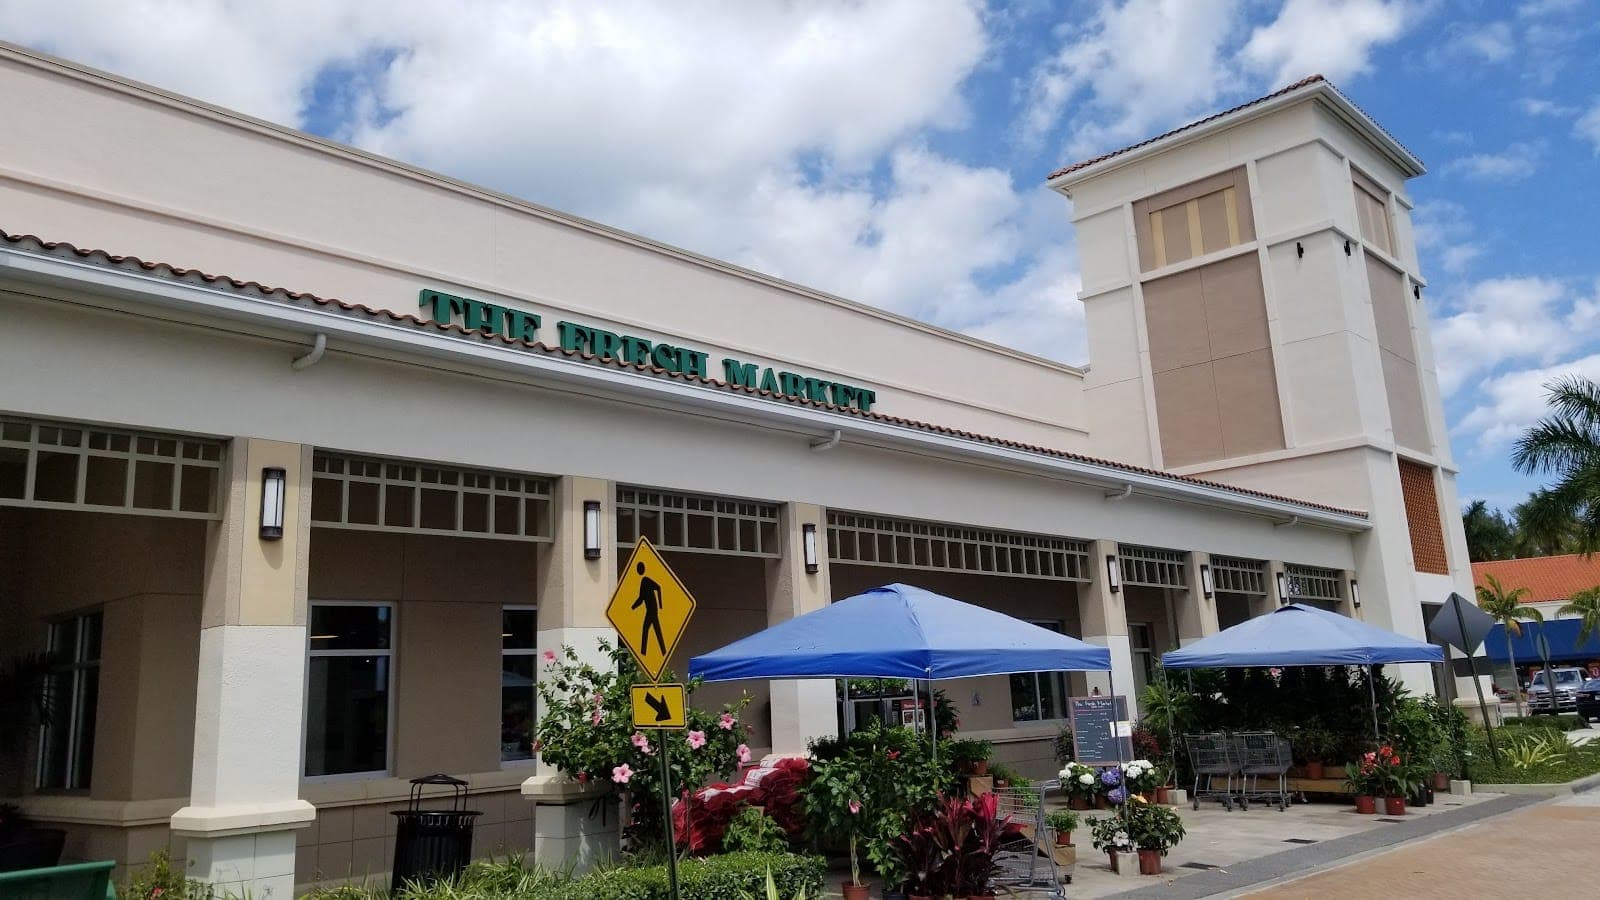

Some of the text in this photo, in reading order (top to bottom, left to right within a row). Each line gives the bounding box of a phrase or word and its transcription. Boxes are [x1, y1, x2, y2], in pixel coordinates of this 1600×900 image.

[419, 289, 876, 411] THE FRESH MARKET
